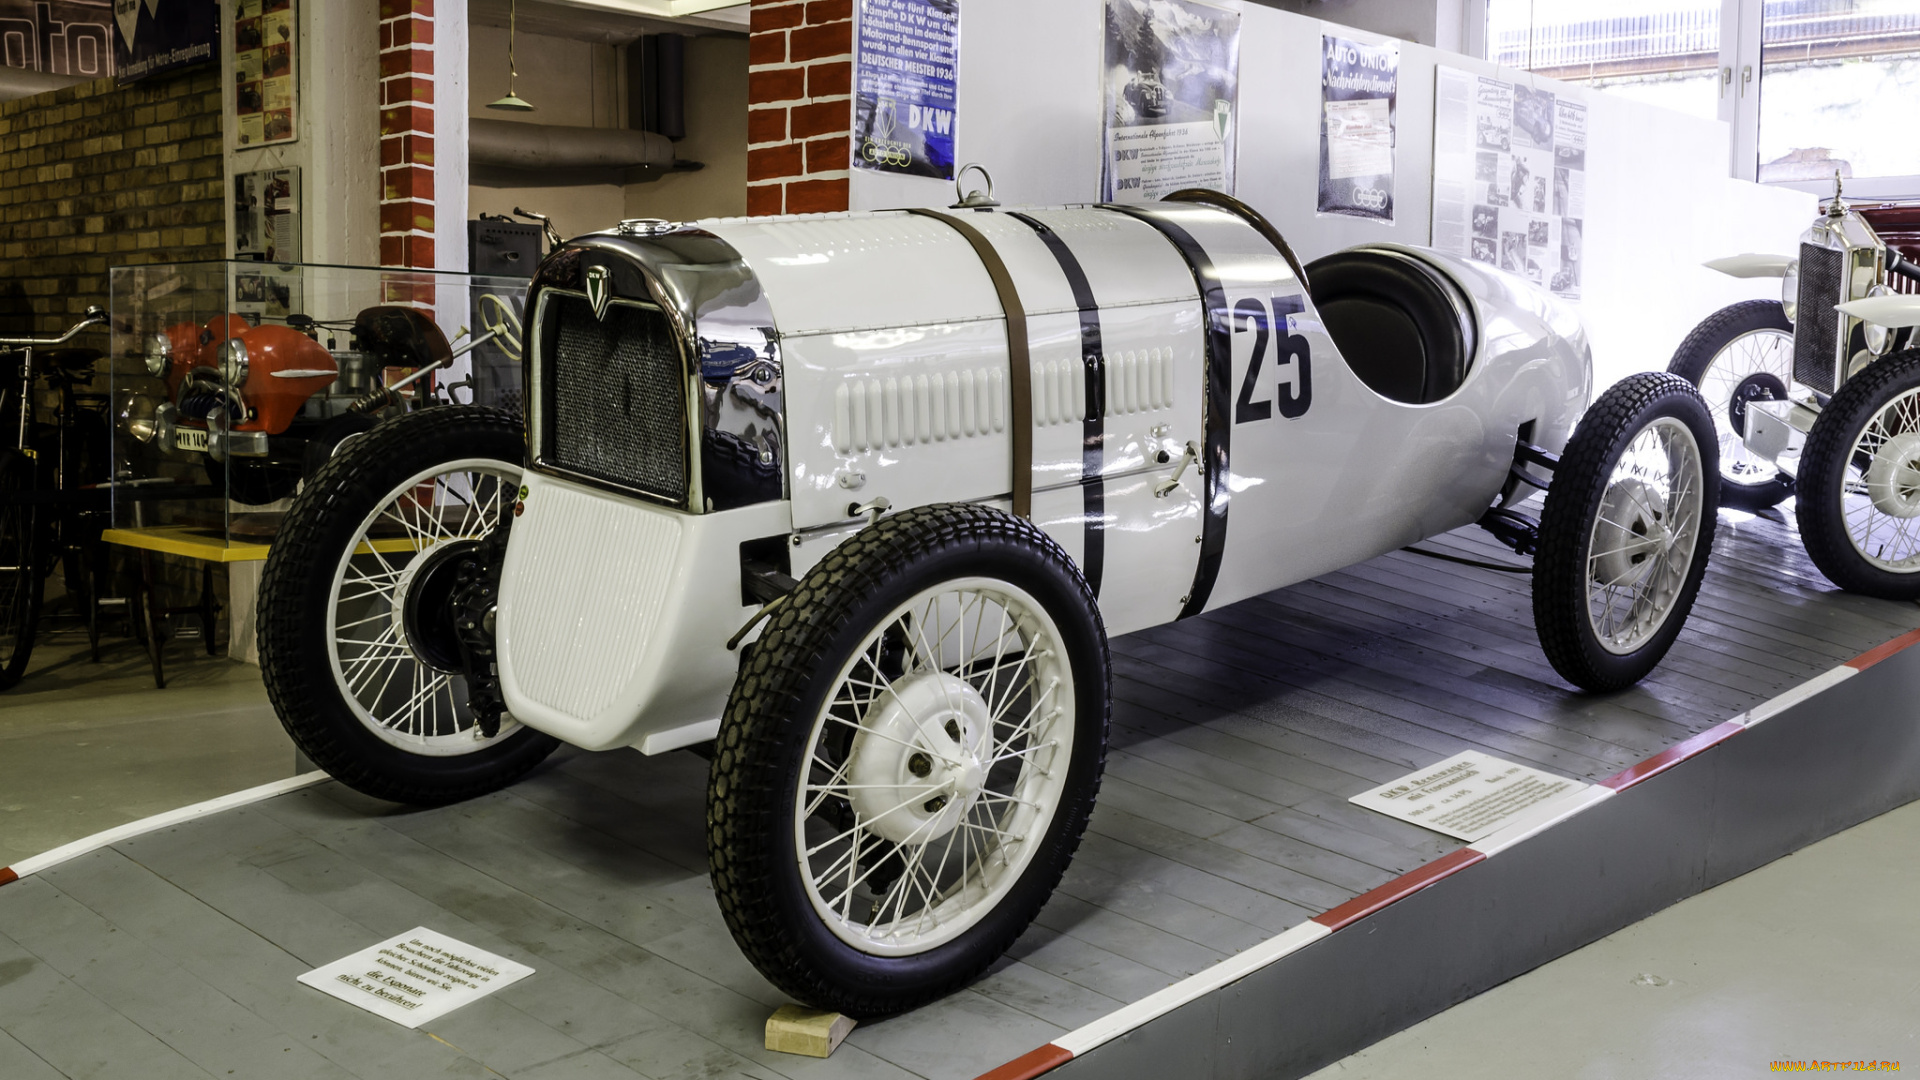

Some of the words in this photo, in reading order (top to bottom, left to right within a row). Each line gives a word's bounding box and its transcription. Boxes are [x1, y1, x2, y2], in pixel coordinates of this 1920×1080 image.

[891, 1, 905, 10] der
[907, 2, 925, 15] fünf
[926, 6, 956, 22] Klassen
[862, 14, 894, 31] höchsten
[894, 21, 914, 35] Ehren
[914, 26, 924, 37] im
[927, 20, 941, 30] um
[862, 40, 887, 52] wurde
[887, 42, 895, 53] in
[895, 45, 914, 58] allen
[914, 50, 929, 60] vier
[929, 51, 954, 65] Klassen
[940, 44, 954, 55] und
[1326, 43, 1358, 66] AUTO
[1360, 51, 1394, 74] UNION
[861, 51, 903, 71] DEUTSCHER
[904, 60, 935, 78] MEISTER
[935, 67, 954, 81] 1936
[909, 104, 952, 135] DKW
[1113, 131, 1148, 142] Internationale
[1114, 148, 1139, 162] DKW
[1117, 176, 1141, 191] DKW
[588, 271, 600, 279] DKW
[1233, 294, 1312, 424] 25
[1407, 793, 1426, 801] mit
[1421, 770, 1480, 794] Frontantrieb
[378, 949, 409, 962] gleicher
[407, 959, 445, 976] Schönheit
[443, 974, 469, 985] zeigen
[395, 943, 433, 960] Besuchern
[432, 957, 445, 965] die
[444, 962, 482, 978] Fahrzeuge
[409, 939, 423, 947] Um
[422, 945, 442, 954] noch
[440, 952, 477, 968] möglichst
[476, 965, 500, 976] vielen
[366, 970, 384, 980] die
[382, 975, 427, 996] Exponate
[404, 969, 427, 981] bitten
[337, 974, 363, 986] nicht
[374, 987, 424, 1009] berühren!
